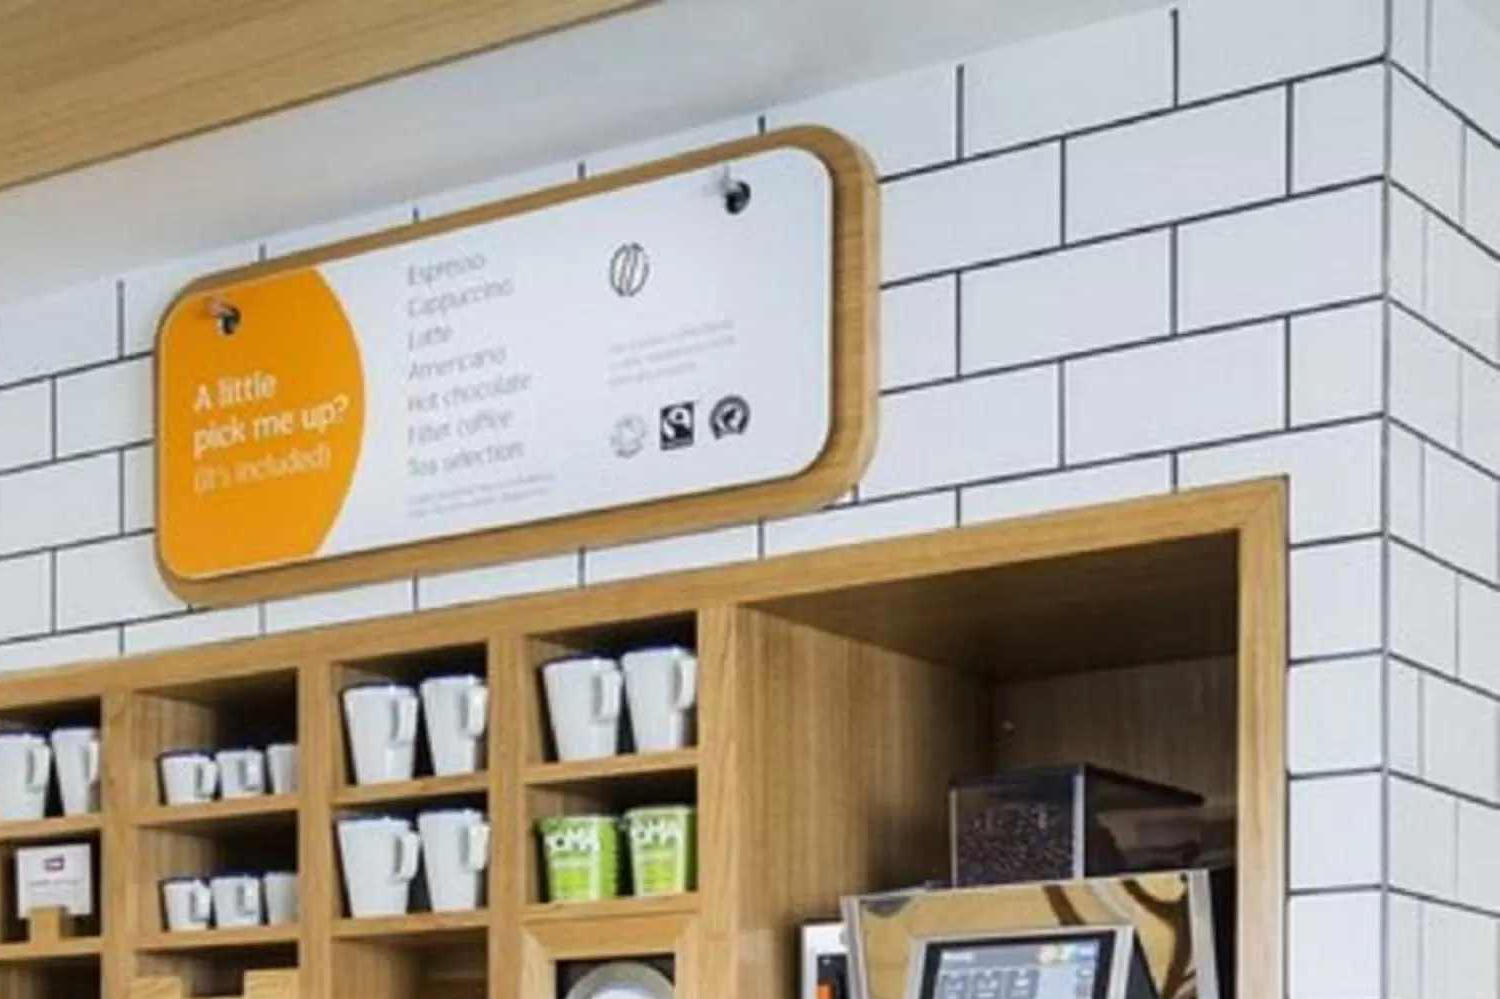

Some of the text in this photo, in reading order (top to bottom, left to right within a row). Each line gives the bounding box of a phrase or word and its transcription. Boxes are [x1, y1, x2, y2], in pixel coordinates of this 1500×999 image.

[407, 251, 488, 287] Espresso
[407, 278, 515, 318] Cappuccino
[407, 347, 507, 381] Americano
[193, 370, 278, 414] A little
[441, 373, 534, 406] chocolate
[193, 393, 351, 462] pick me up?
